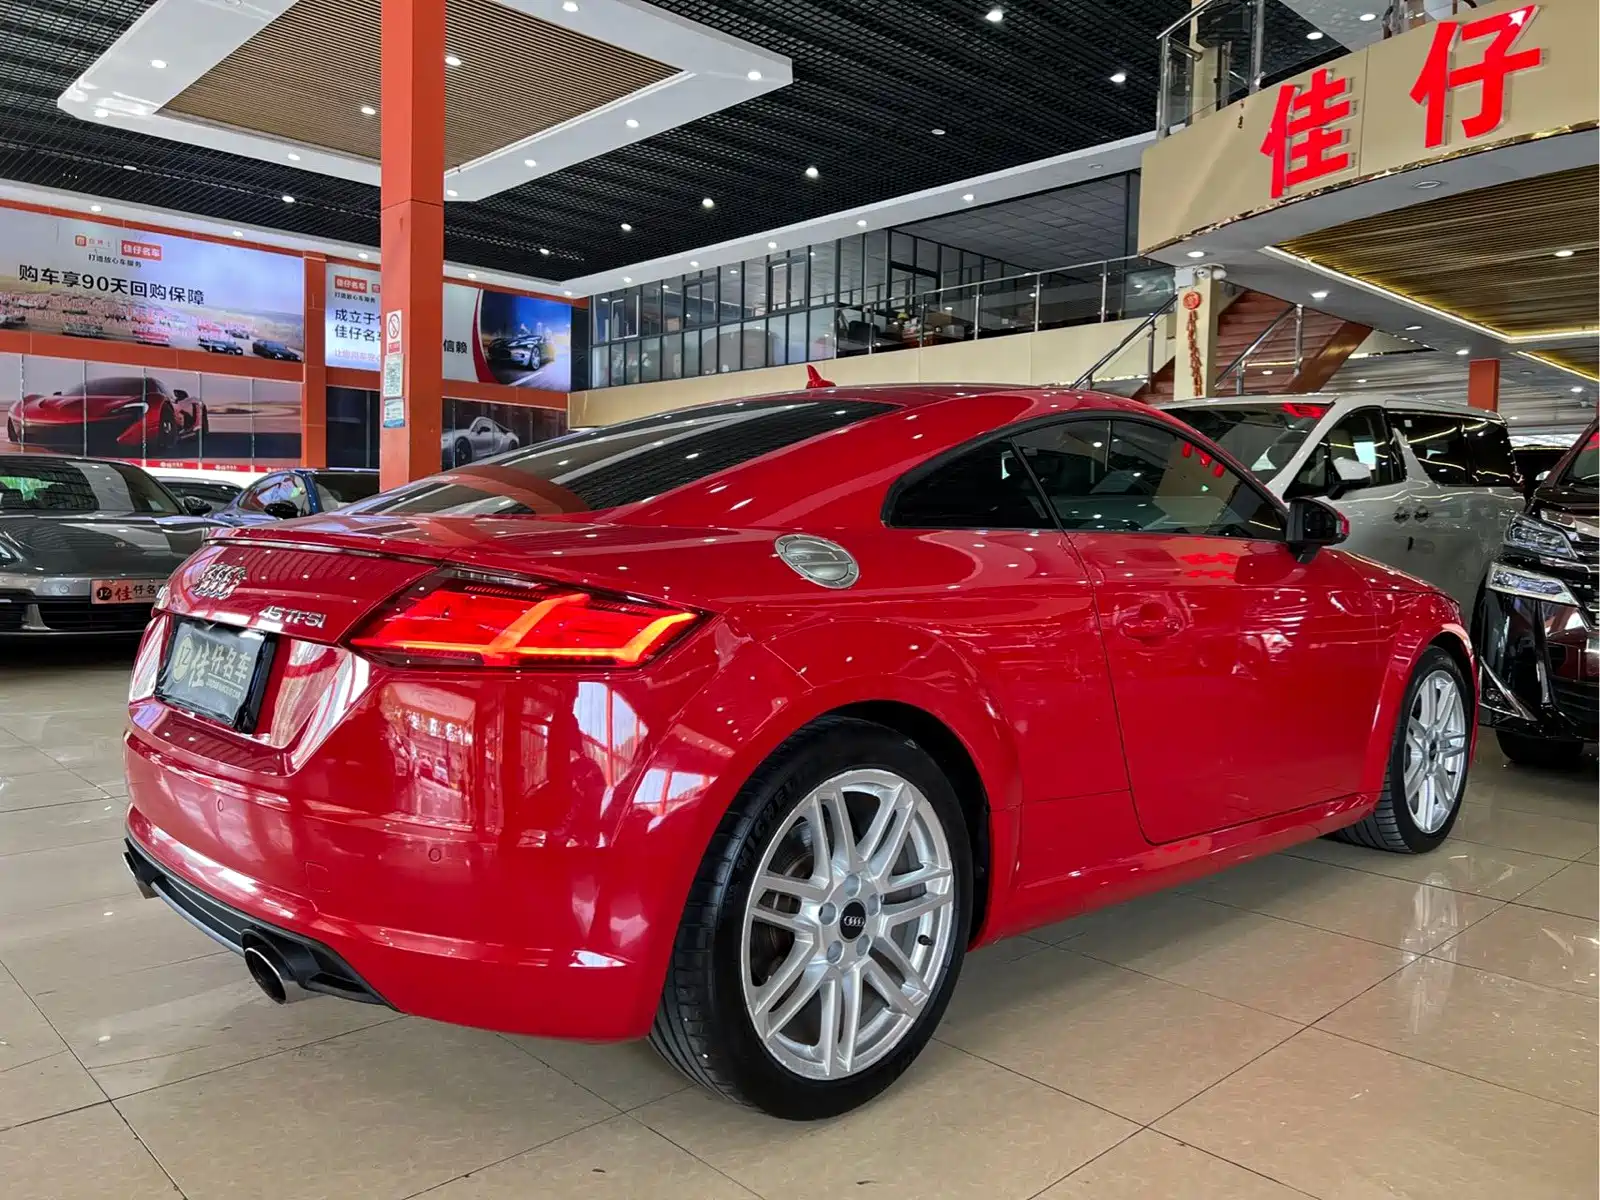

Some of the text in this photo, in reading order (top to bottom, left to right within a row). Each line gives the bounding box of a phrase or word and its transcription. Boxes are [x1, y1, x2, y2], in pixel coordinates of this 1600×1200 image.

[1260, 4, 1544, 198] 佳仔
[122, 243, 161, 258] 佳仔名车
[18, 263, 205, 305] 购车享90天回购保障
[115, 585, 162, 601] 佳仔名
[188, 640, 252, 688] 佳仔名车
